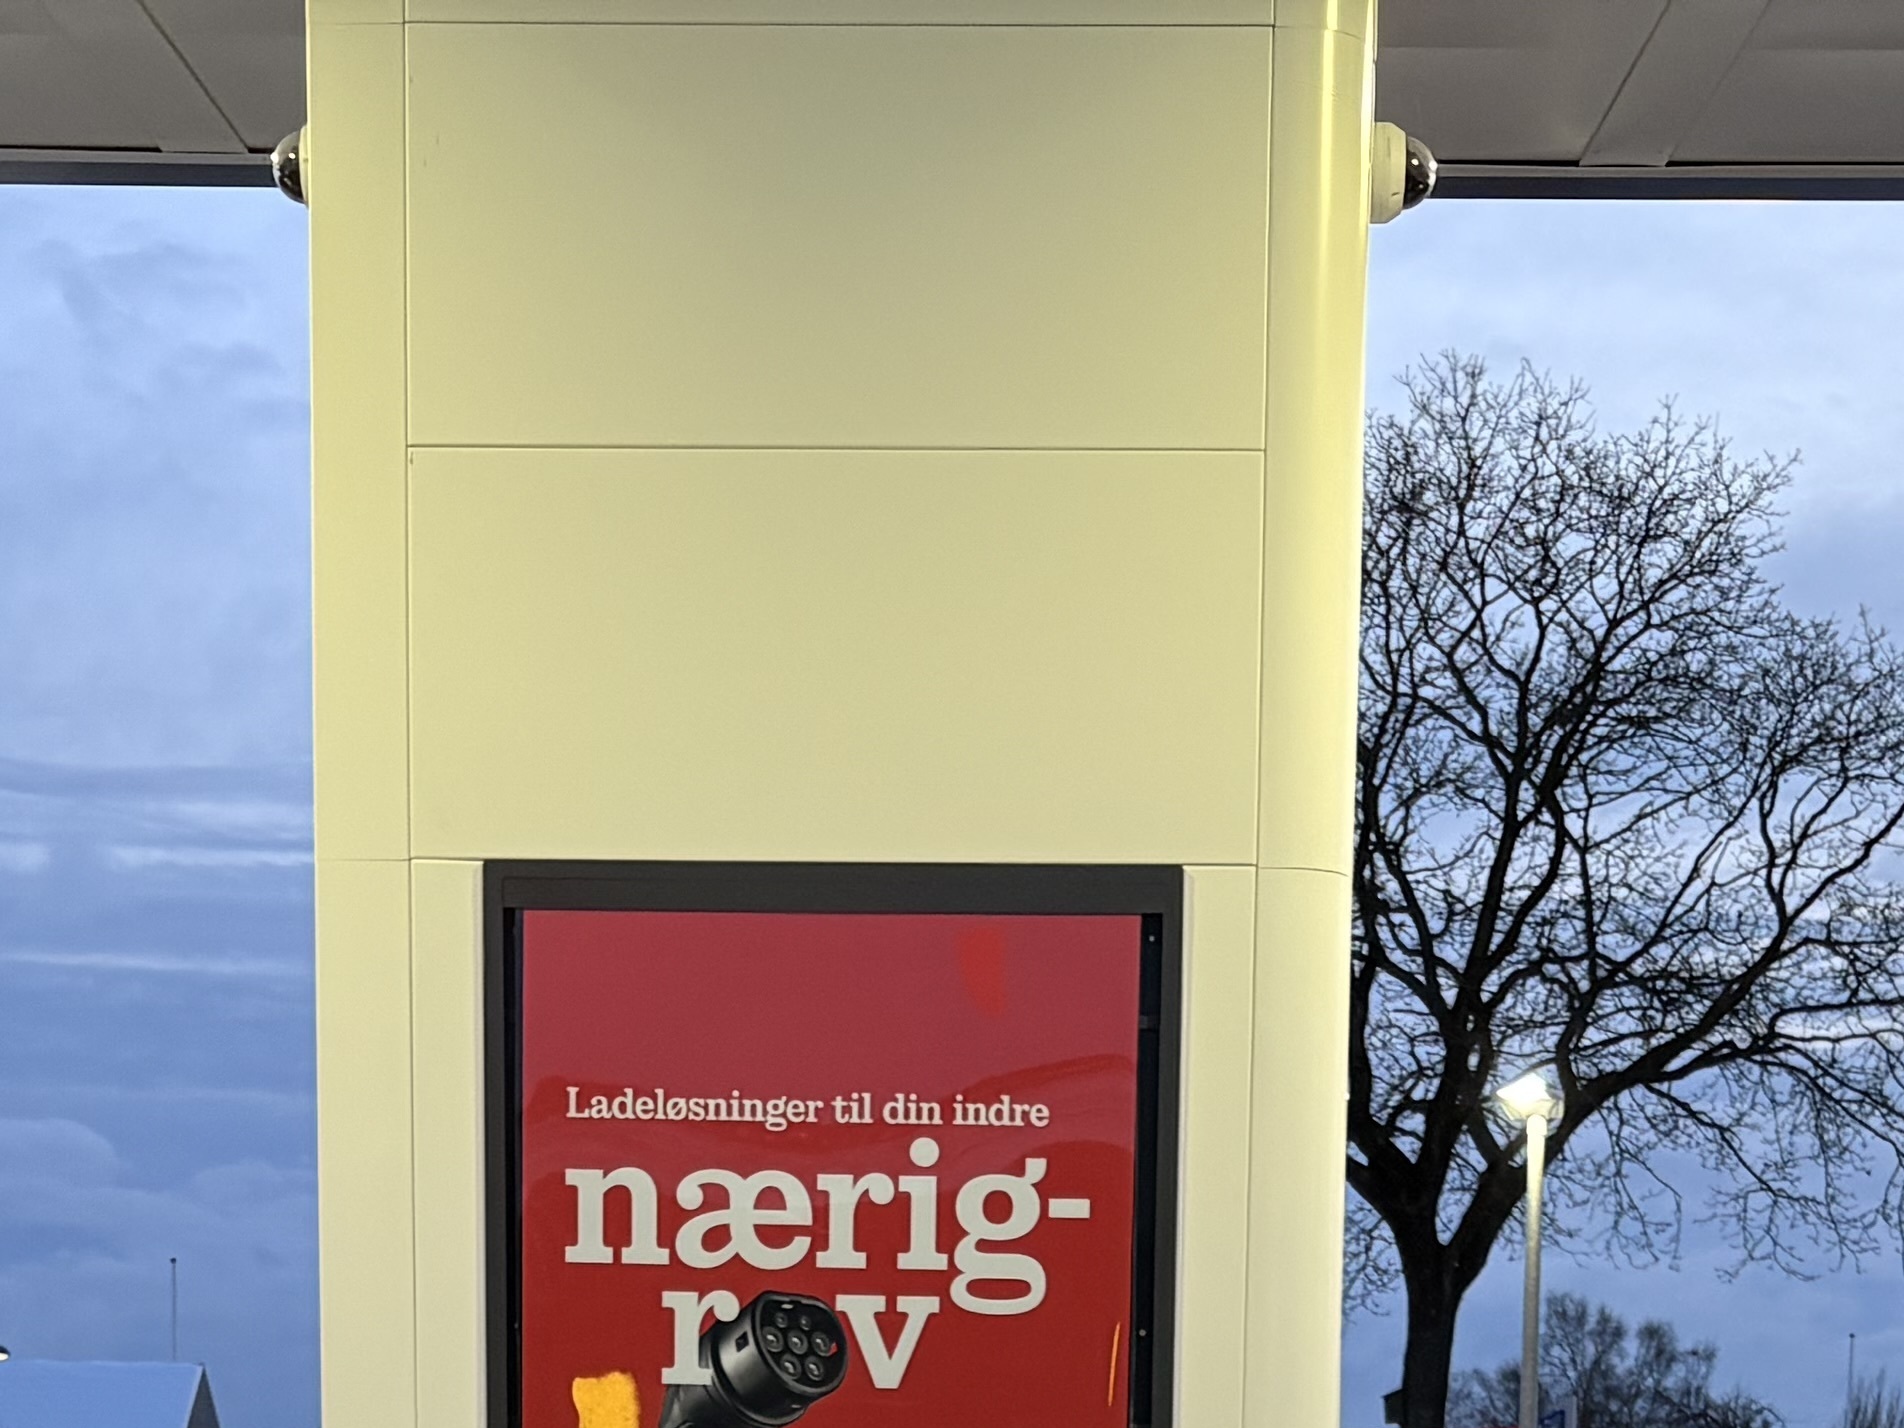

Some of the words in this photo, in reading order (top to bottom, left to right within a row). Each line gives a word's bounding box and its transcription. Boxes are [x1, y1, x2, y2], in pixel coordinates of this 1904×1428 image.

[566, 1086, 824, 1131] Ladeløsninger
[831, 1093, 873, 1125] til
[883, 1093, 943, 1125] din
[952, 1095, 1050, 1127] indre
[564, 1137, 1091, 1315] nærig-
